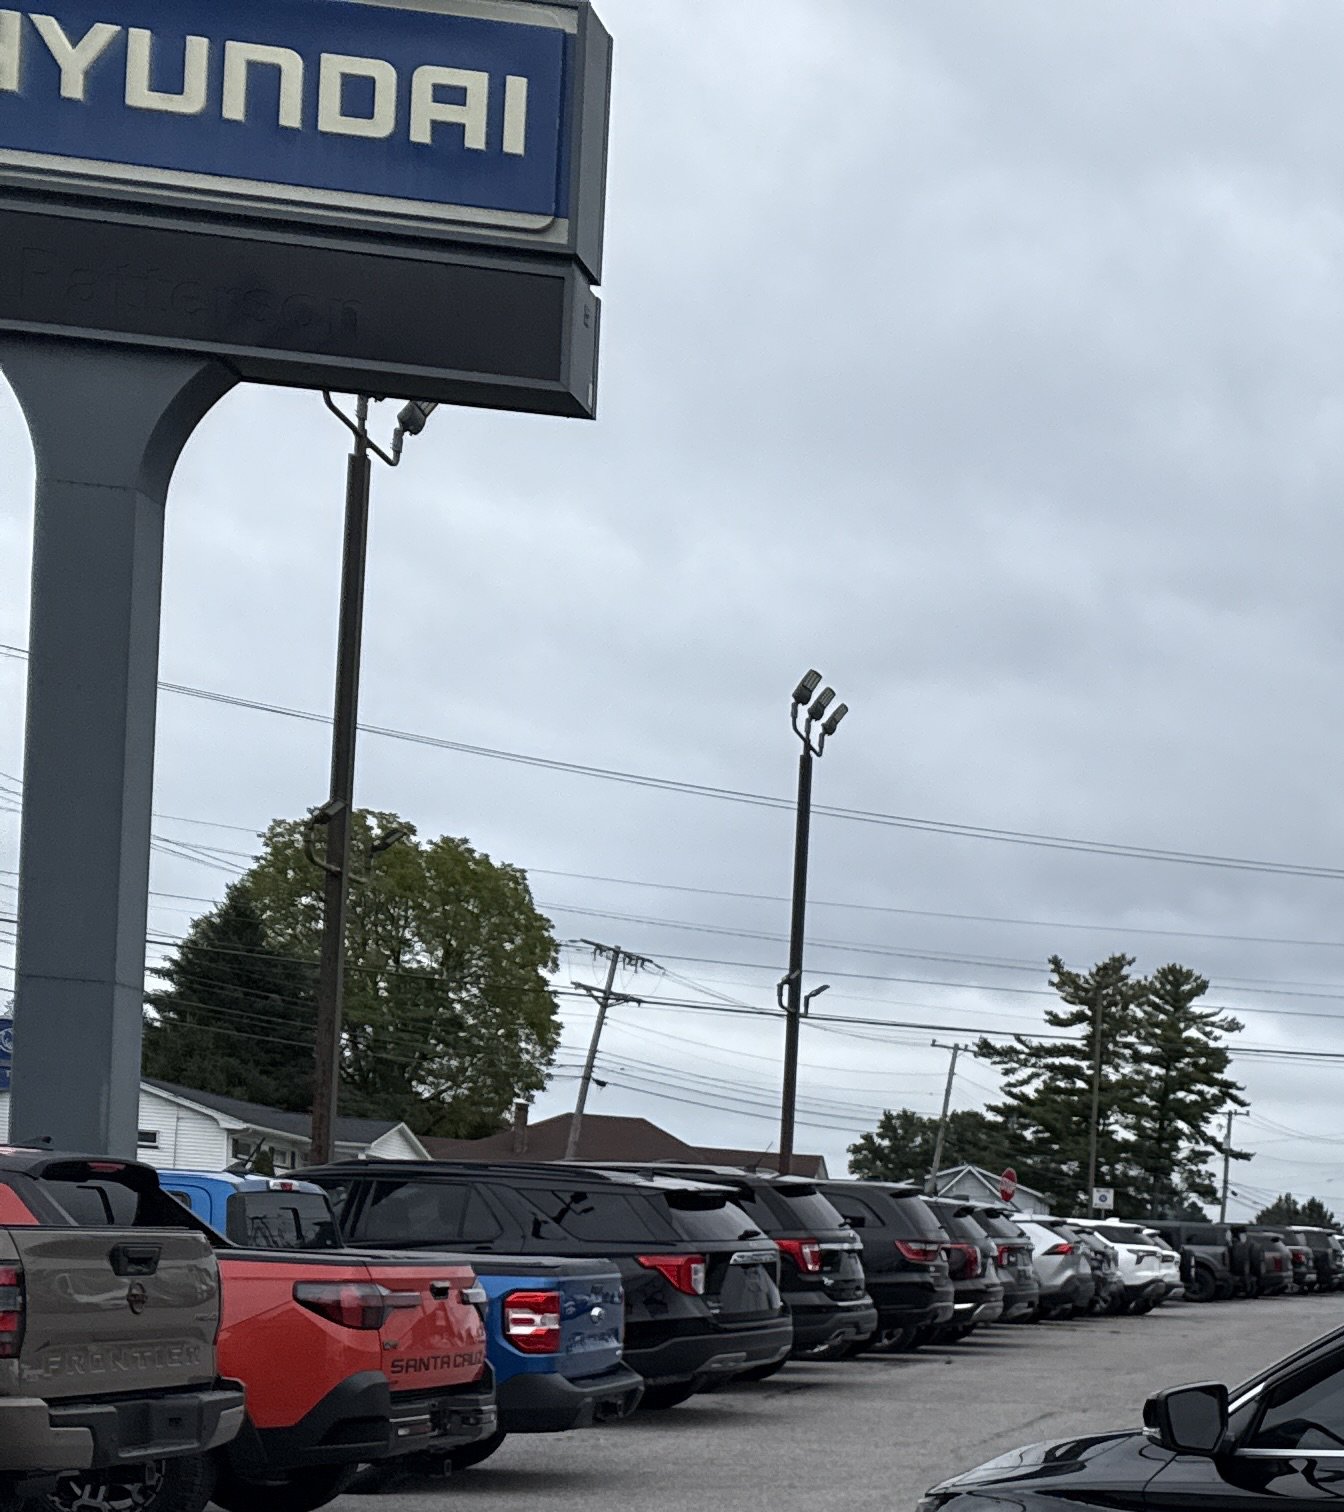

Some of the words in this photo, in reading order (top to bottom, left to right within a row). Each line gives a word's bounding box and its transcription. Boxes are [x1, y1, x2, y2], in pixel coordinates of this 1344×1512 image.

[0, 9, 528, 156] YUNDAI
[43, 1343, 201, 1377] FRONTIER
[391, 1354, 451, 1374] SANTA
